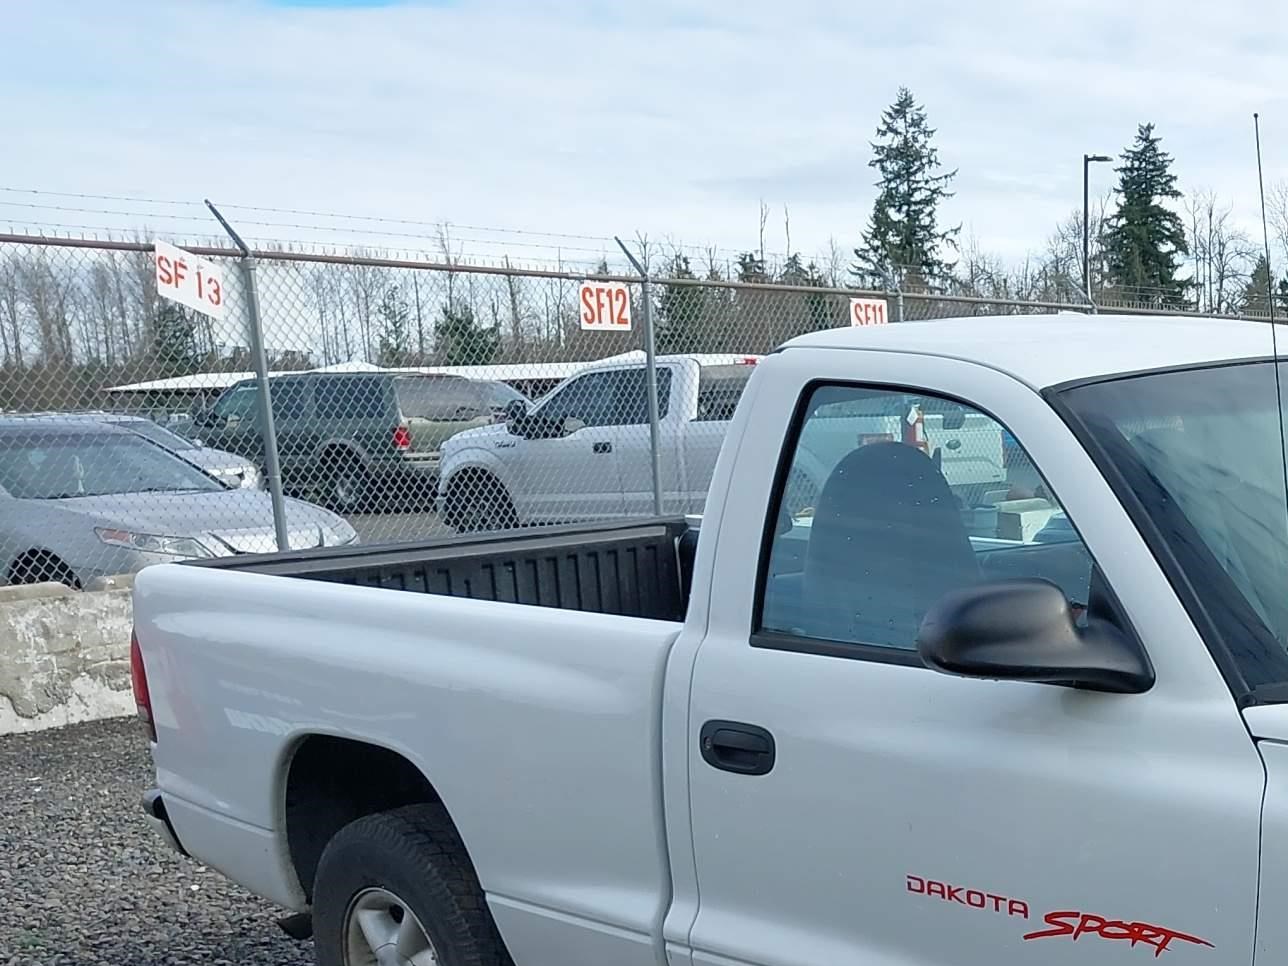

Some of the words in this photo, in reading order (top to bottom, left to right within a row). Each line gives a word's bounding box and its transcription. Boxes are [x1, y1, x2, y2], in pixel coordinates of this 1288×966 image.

[157, 255, 188, 289] SF
[196, 271, 221, 306] 13
[581, 286, 629, 325] SF12
[854, 302, 884, 326] SF11
[906, 874, 1029, 919] DAKOTA
[1022, 911, 1216, 958] SPORT
